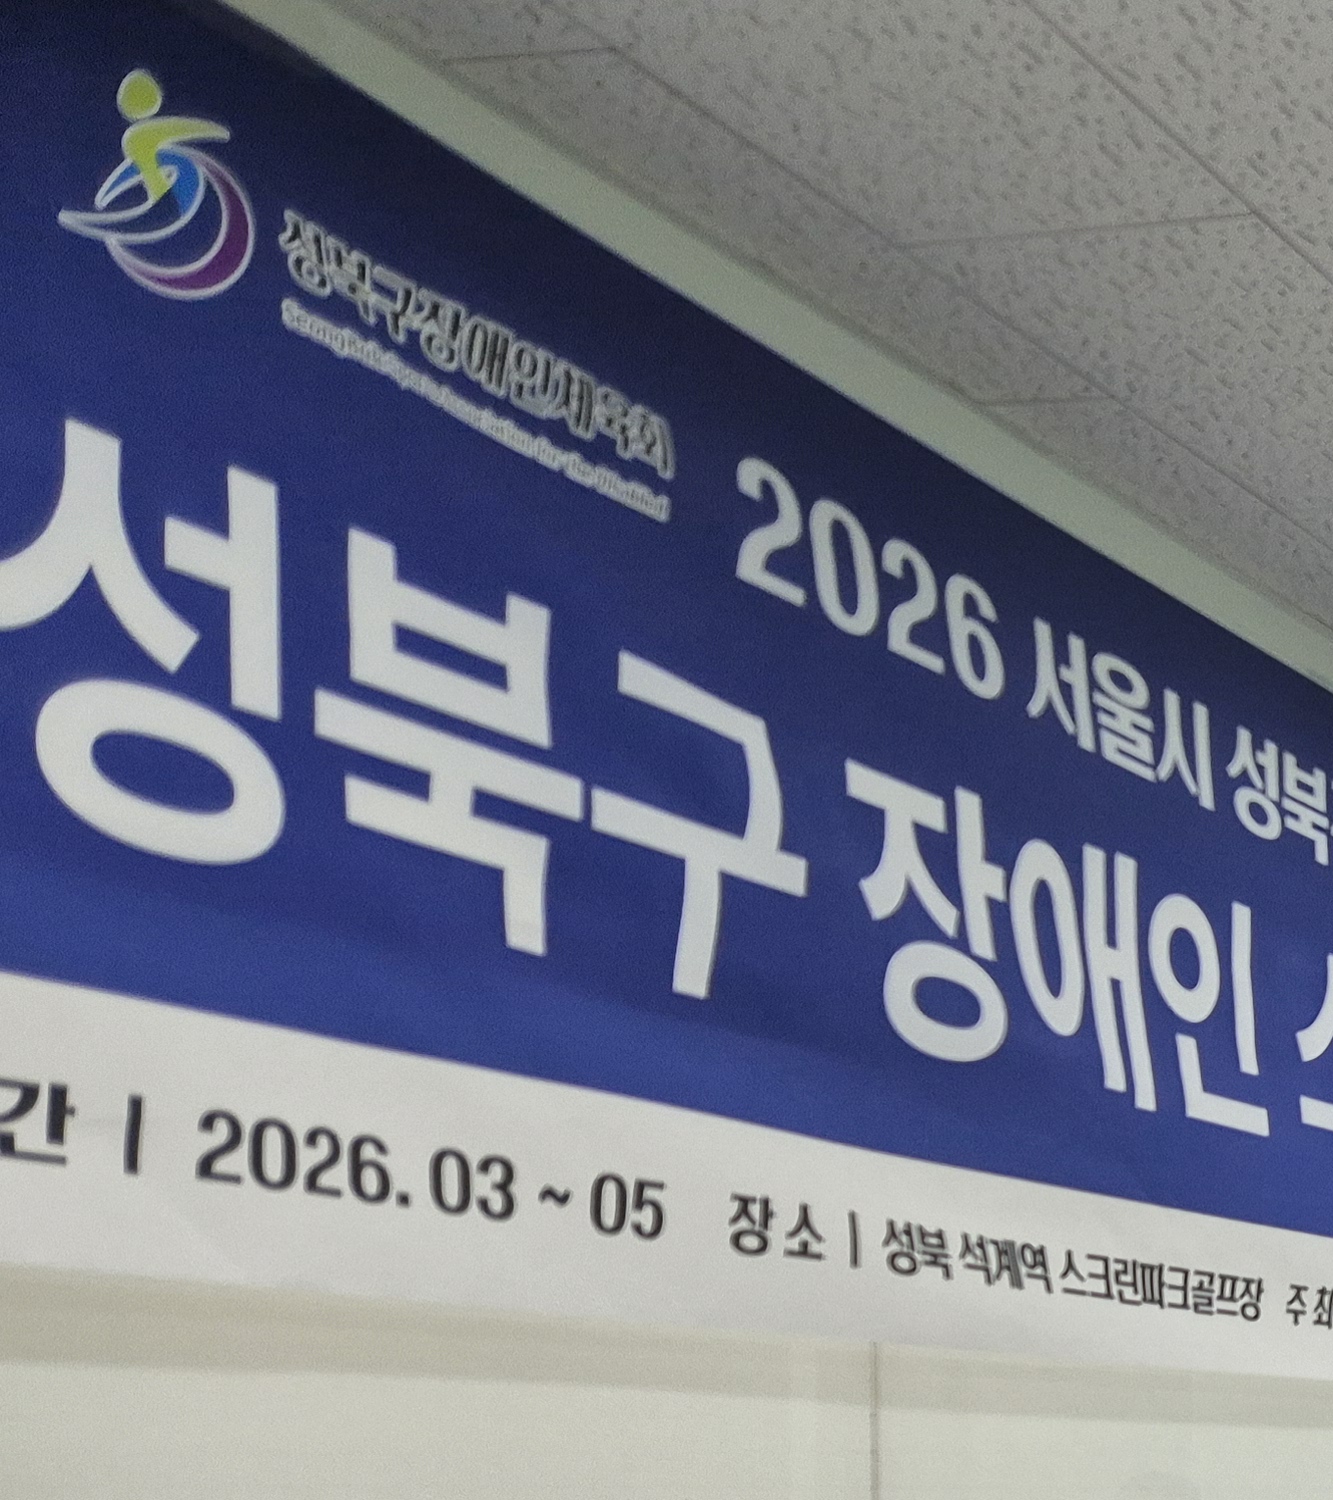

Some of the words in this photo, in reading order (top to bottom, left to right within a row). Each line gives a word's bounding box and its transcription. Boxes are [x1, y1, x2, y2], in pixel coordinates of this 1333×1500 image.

[278, 208, 675, 480] 성북구장애인체육회
[0, 416, 808, 1000] 성북구
[844, 757, 1270, 1137] 장애인
[736, 457, 1005, 699] 2026
[1026, 616, 1215, 811] 서울시
[727, 1192, 827, 1262] 장소
[881, 1218, 955, 1281] 성북
[958, 1232, 1054, 1294] 석계역
[1058, 1248, 1265, 1322] 스크린파크골프장
